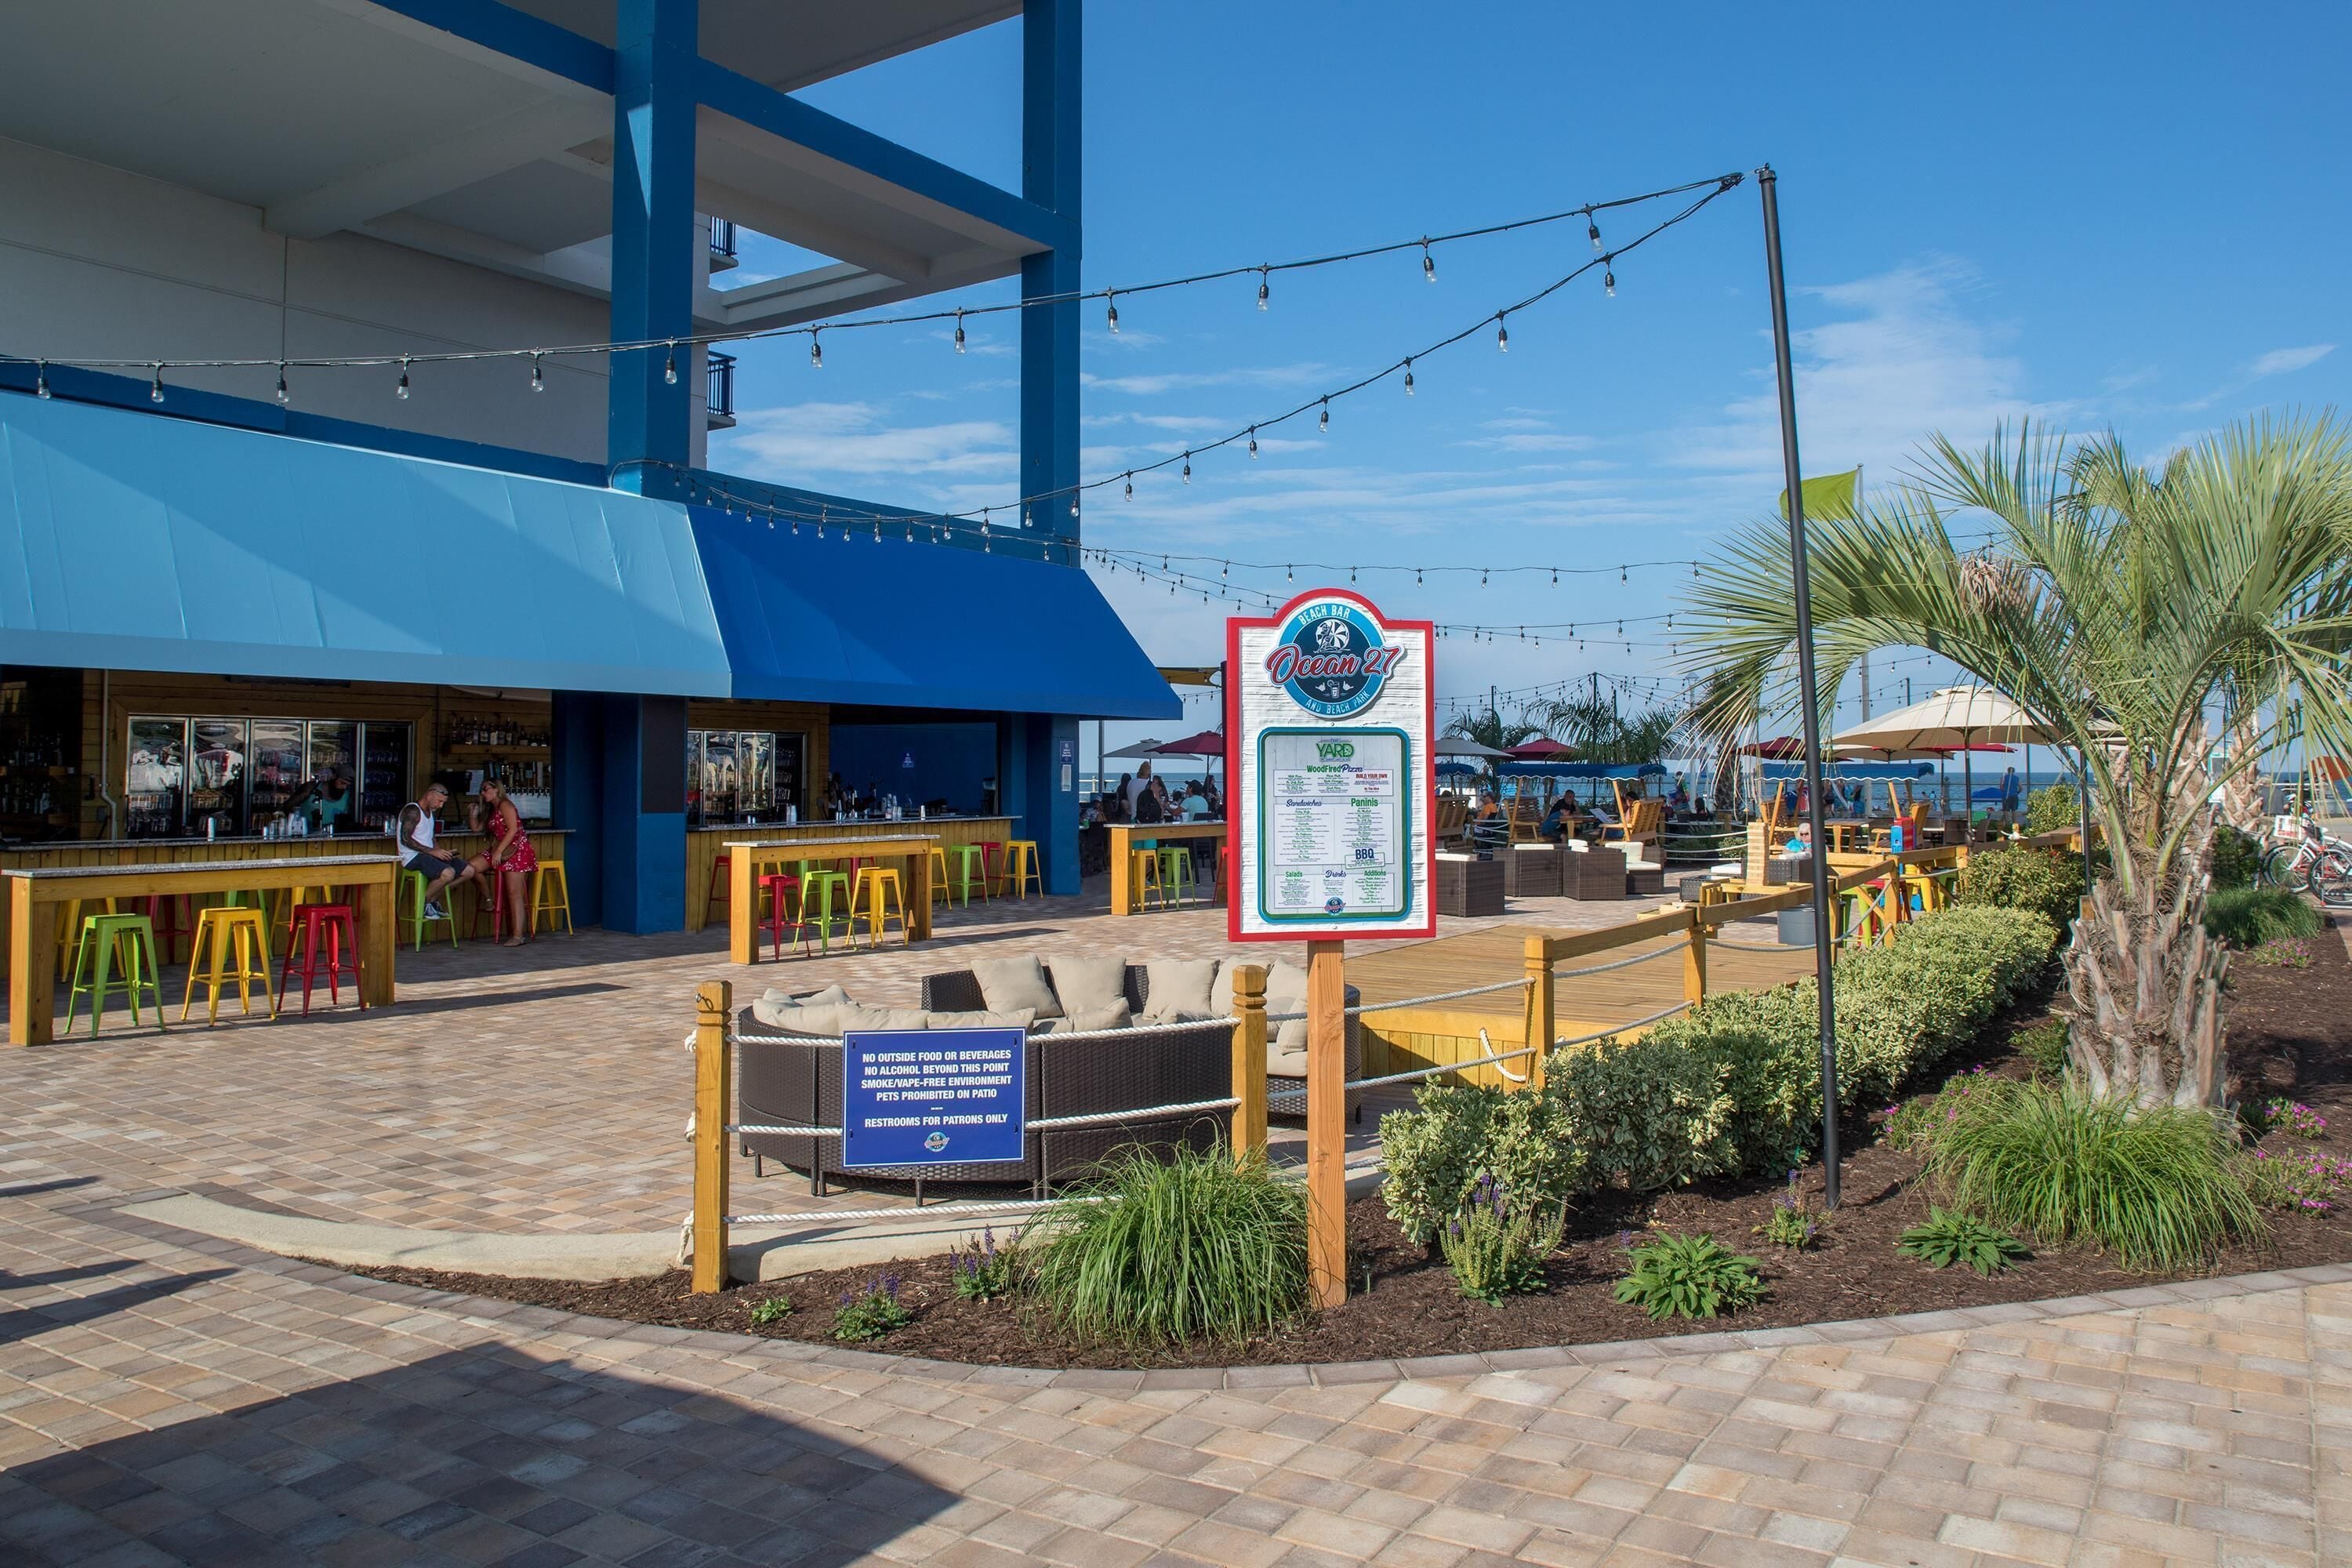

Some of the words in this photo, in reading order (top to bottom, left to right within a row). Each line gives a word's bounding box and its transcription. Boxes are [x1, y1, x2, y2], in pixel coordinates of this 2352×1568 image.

[1298, 605, 1328, 626] BEACH
[1331, 604, 1351, 619] BAR
[1266, 644, 1359, 684] Ocean
[1363, 647, 1400, 674] 27
[1305, 699, 1320, 712] AND
[1327, 702, 1350, 715] BEACH
[1354, 691, 1370, 707] PARK
[1316, 743, 1353, 757] YARD
[1341, 764, 1363, 772] Pizza
[1351, 797, 1378, 807] Paninis
[1356, 848, 1374, 859] BBQ
[862, 1053, 876, 1062] NO
[878, 1052, 916, 1062] OUTSIDE
[919, 1052, 942, 1062] FOOD
[945, 1051, 957, 1061] OR
[960, 1050, 1011, 1060] BEVERAGES
[865, 1066, 877, 1076] NO
[880, 1065, 920, 1075] ALCOHOL
[923, 1064, 958, 1074] BEYOND
[961, 1064, 980, 1073] THIS
[983, 1062, 1009, 1072] POINT
[862, 1078, 946, 1088] SMOKE/VAPE-FREE
[949, 1076, 1012, 1085] ENVIRONMENT
[877, 1091, 899, 1102] PETS
[902, 1091, 954, 1100] PROHIBITED
[957, 1090, 970, 1098] ON
[972, 1089, 996, 1098] PATIO
[865, 1116, 920, 1127] RESTROOMS
[923, 1116, 940, 1126] FOR
[943, 1115, 983, 1125] PATRONS
[985, 1114, 1008, 1123] ONLY
